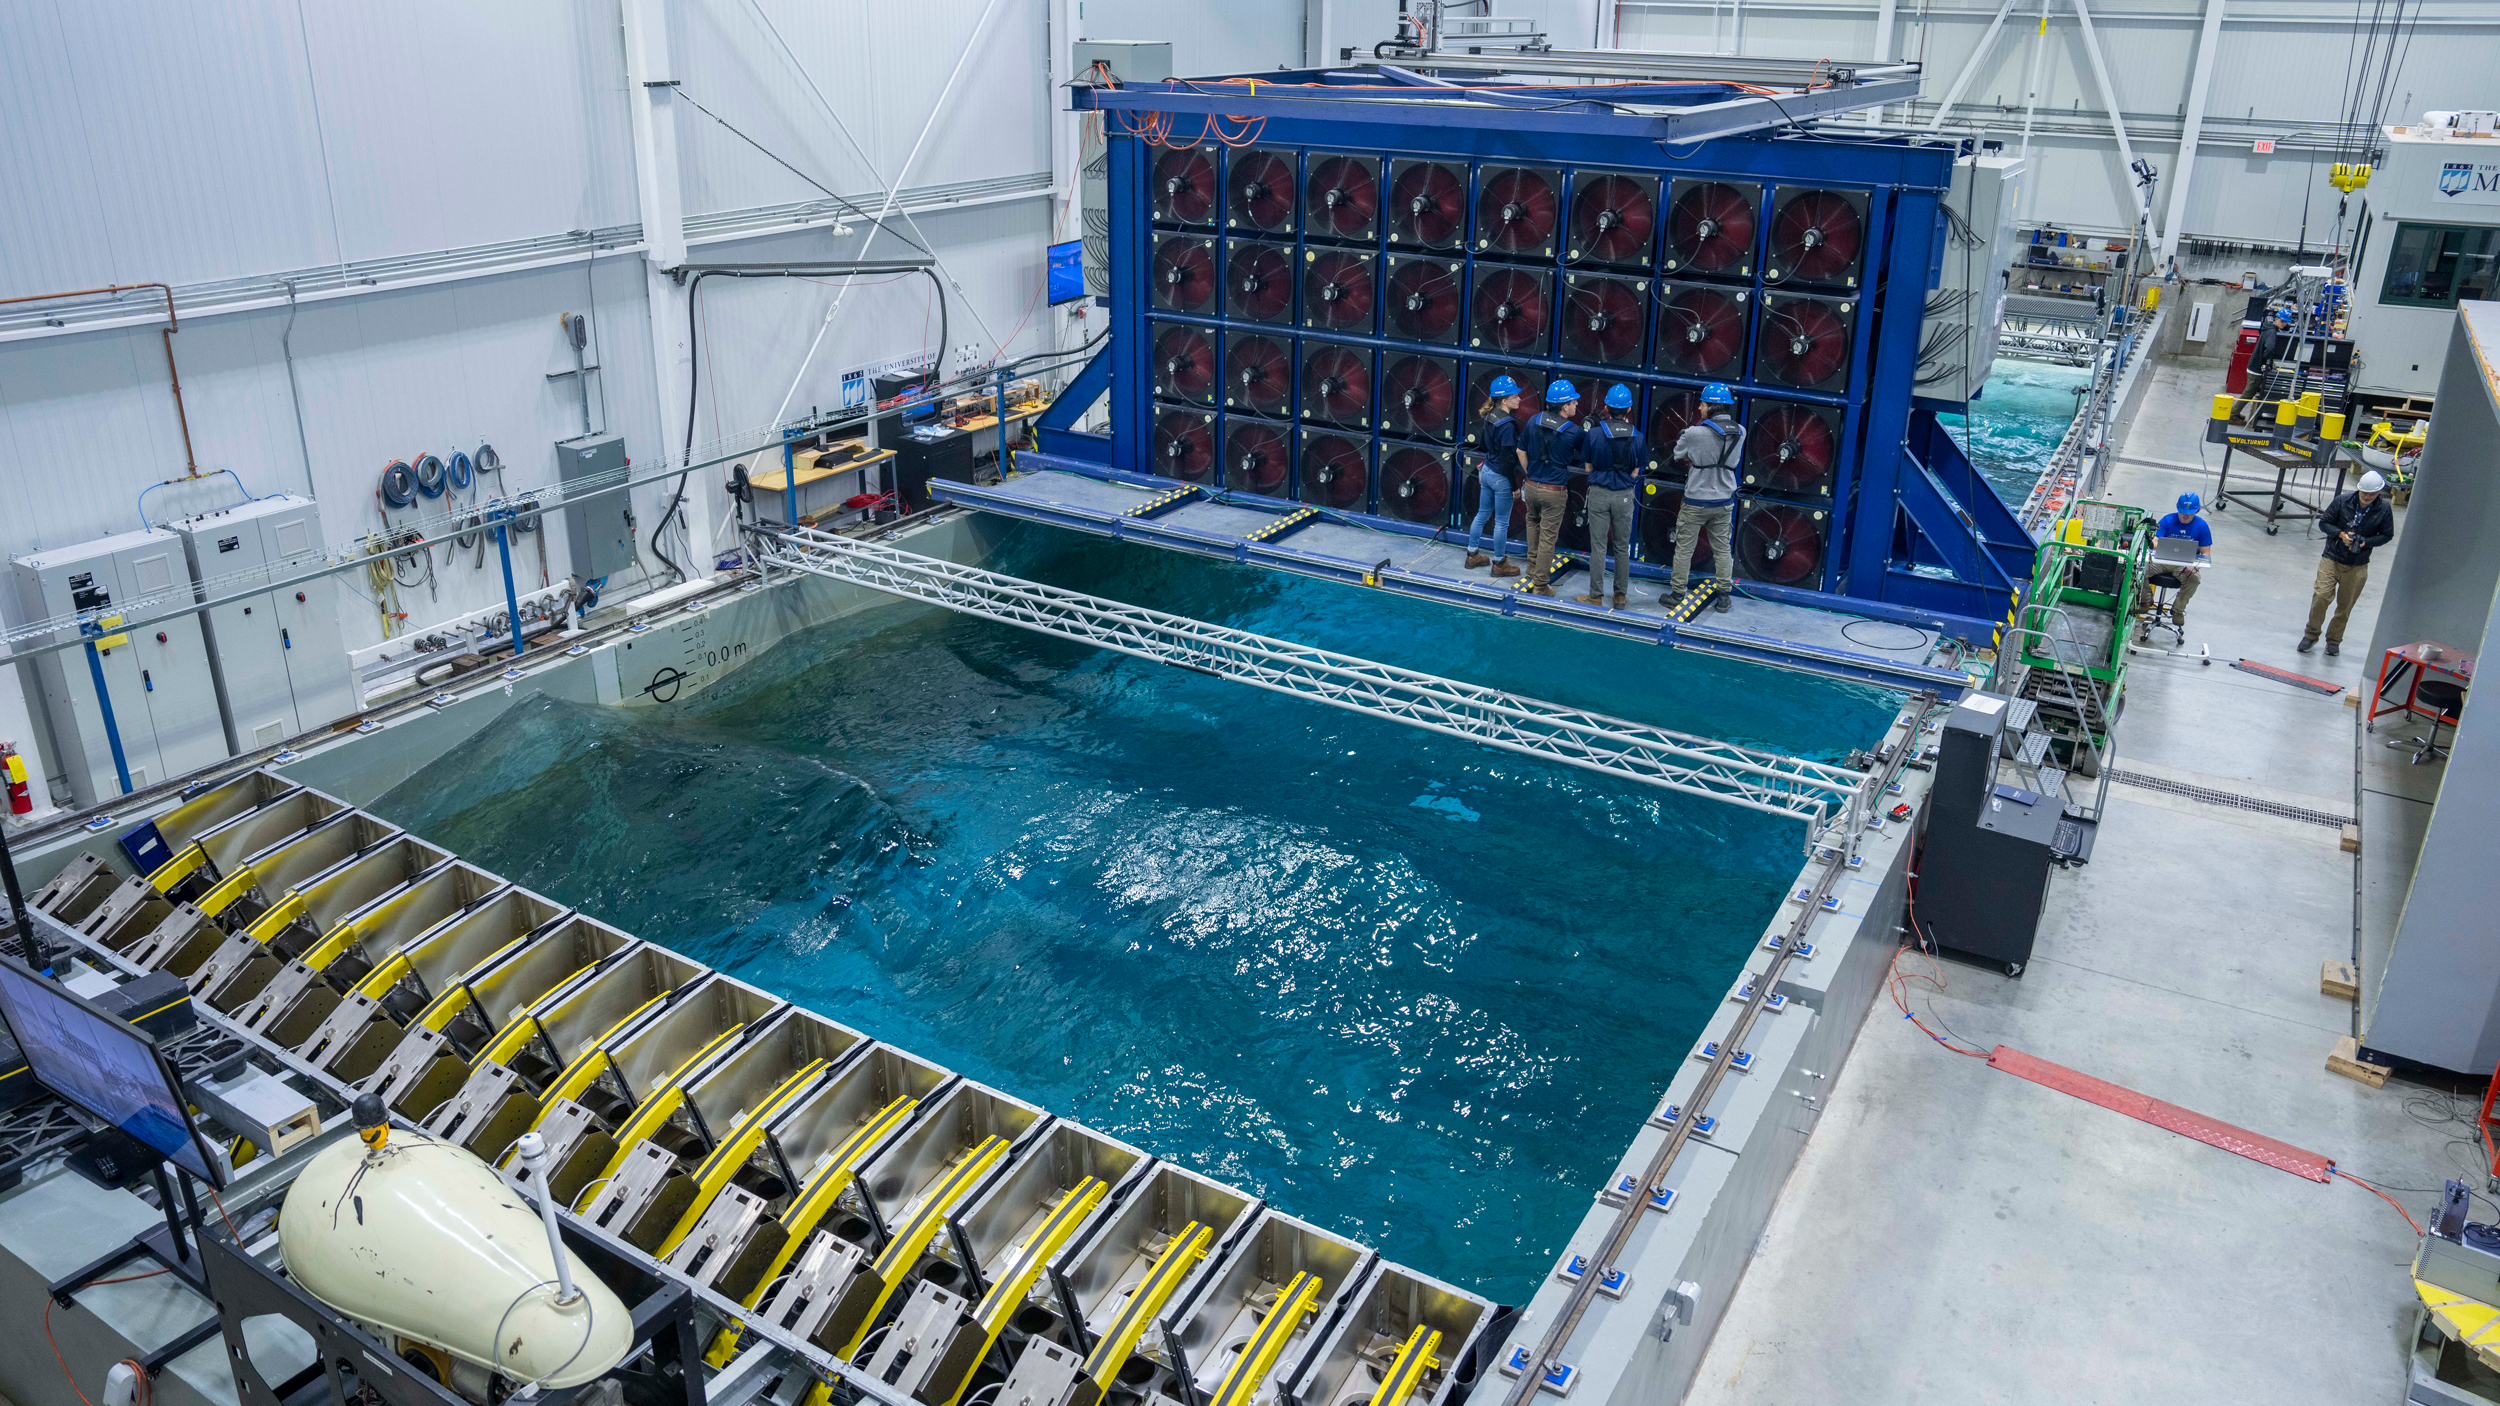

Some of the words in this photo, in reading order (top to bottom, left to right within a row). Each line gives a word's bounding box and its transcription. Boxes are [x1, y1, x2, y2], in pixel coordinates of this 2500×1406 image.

[2256, 141, 2272, 152] EXIT
[868, 366, 881, 375] THE
[884, 356, 925, 370] UNIVERSITY
[927, 352, 936, 360] OF
[843, 370, 863, 380] 1865
[694, 619, 703, 627] 0.4
[695, 630, 705, 638] 0.3
[696, 641, 706, 649] 0.2
[698, 652, 707, 660] 0.1
[707, 646, 730, 667] 0.0
[734, 642, 747, 657] m
[700, 674, 710, 682] 0.1
